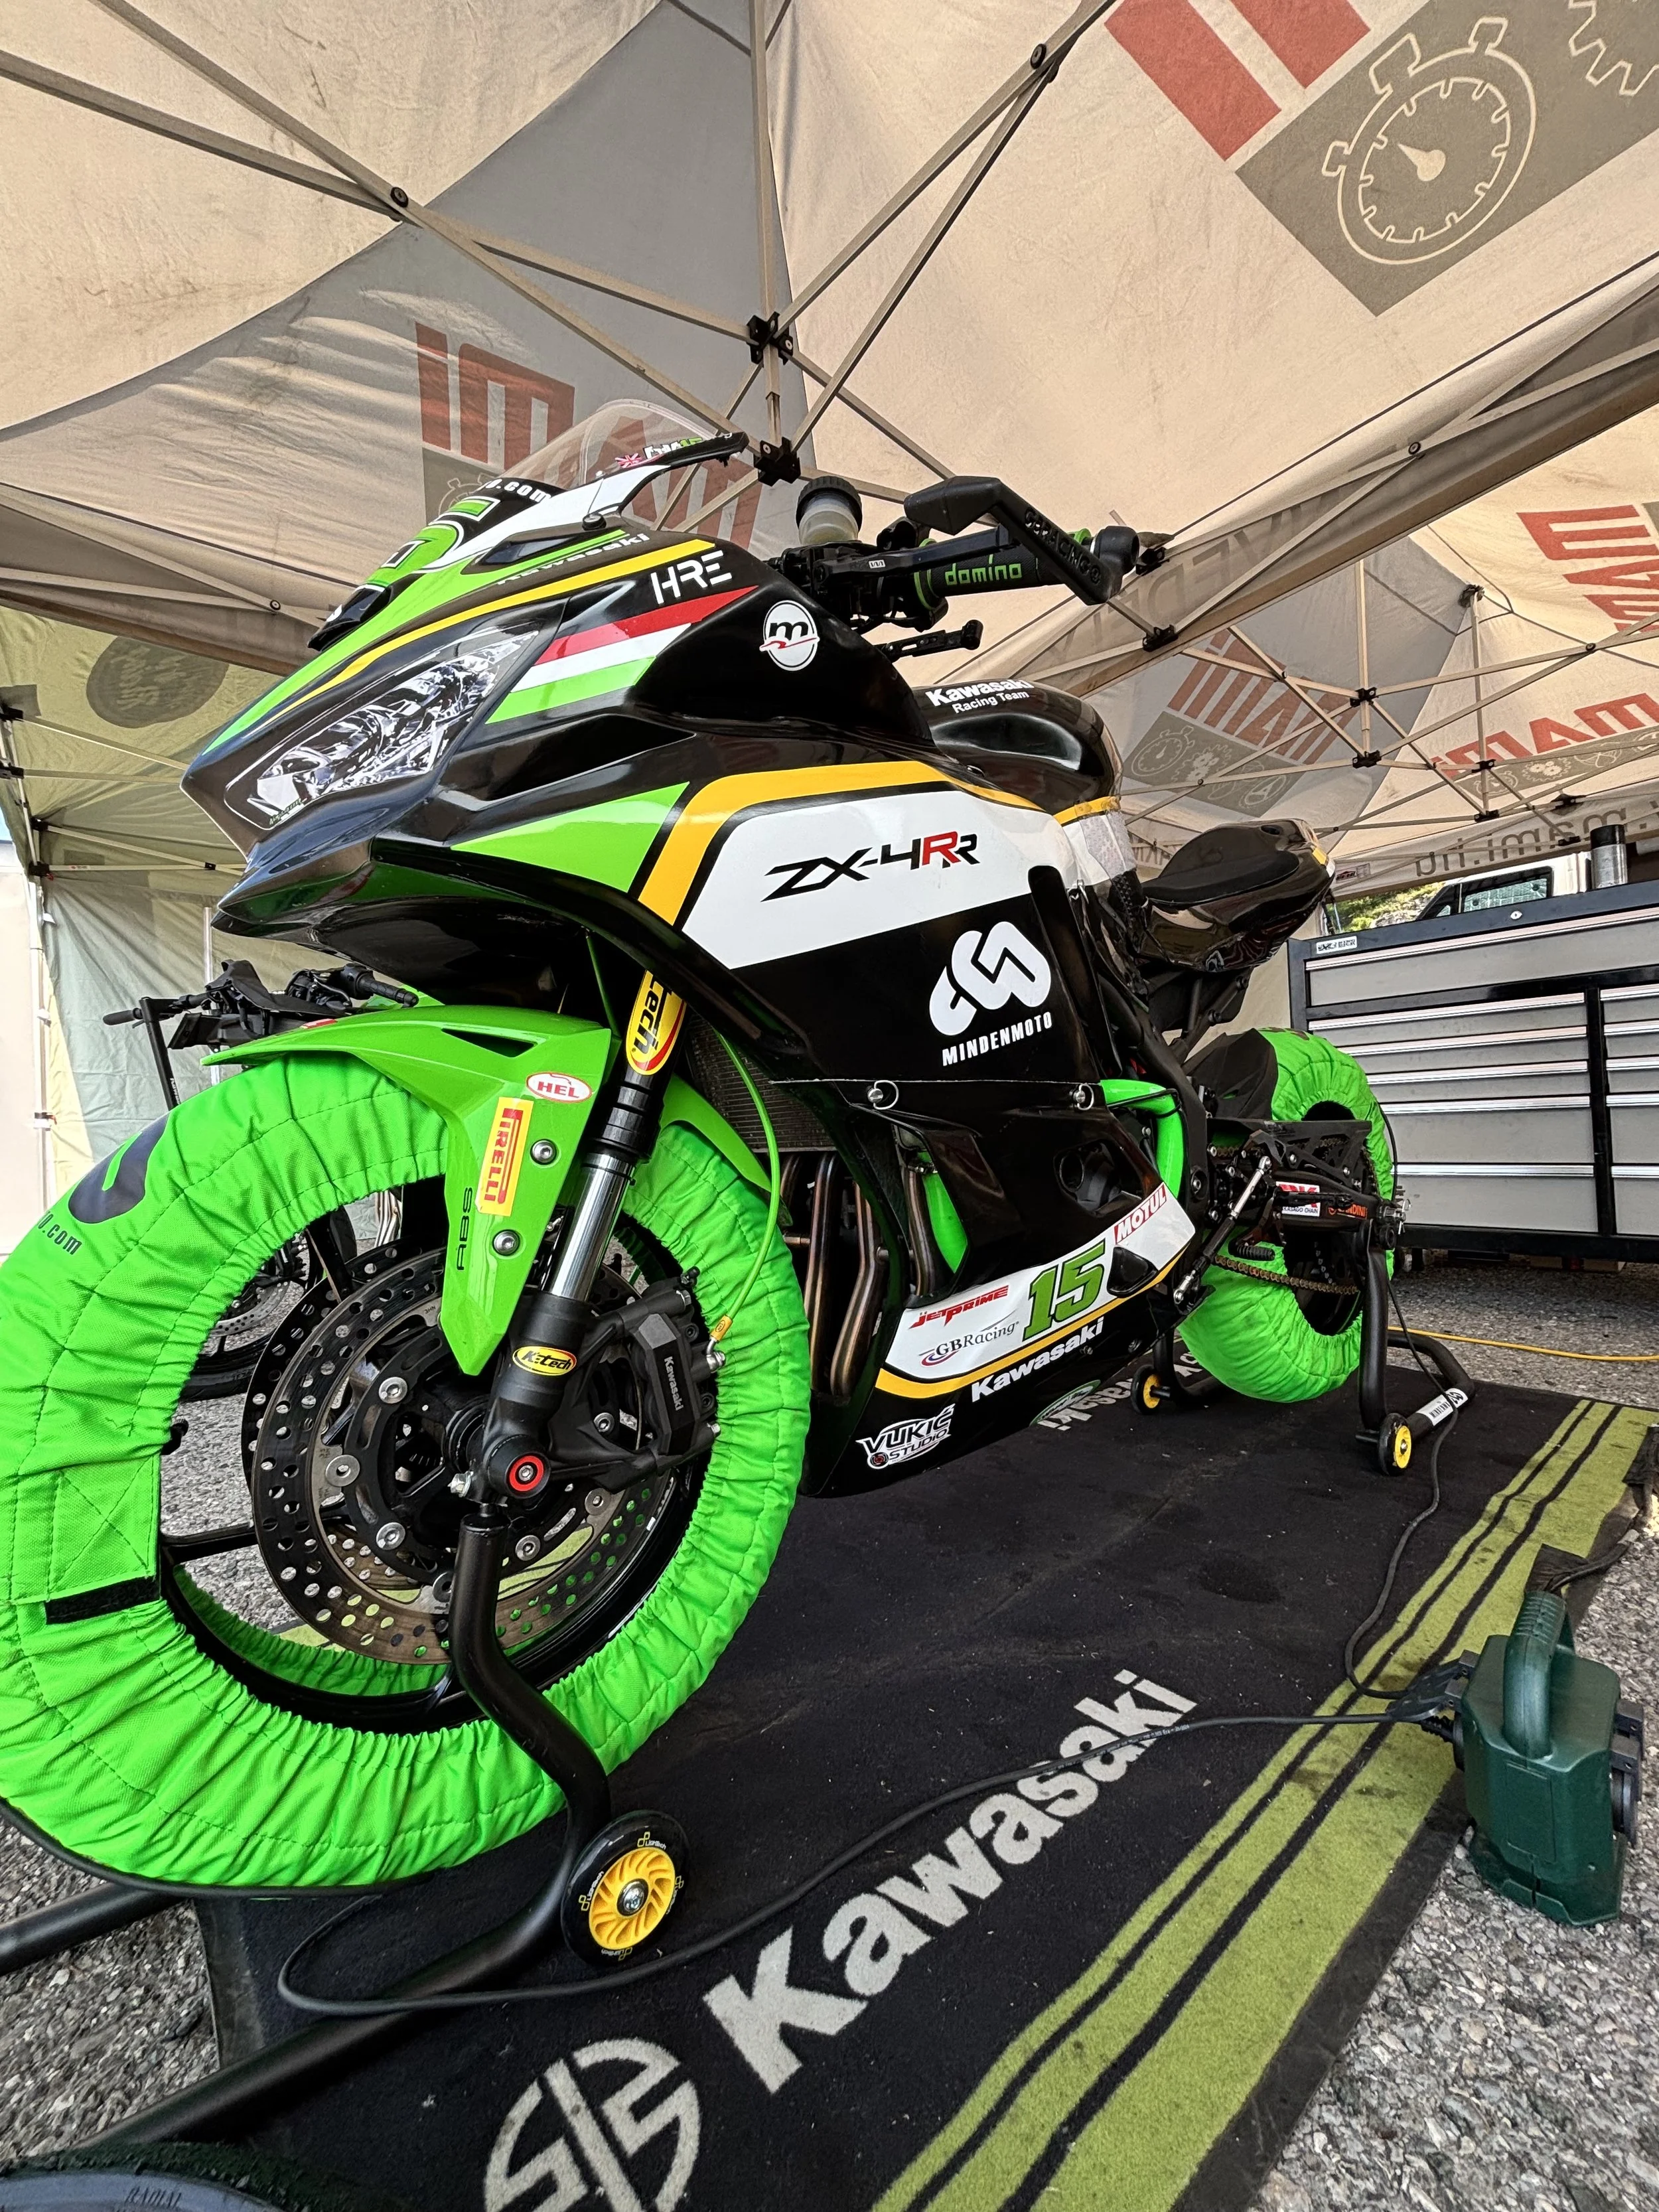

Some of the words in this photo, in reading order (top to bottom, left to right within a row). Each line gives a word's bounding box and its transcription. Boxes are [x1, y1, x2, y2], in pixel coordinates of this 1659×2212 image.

[650, 550, 732, 605] HRE
[945, 554, 1023, 586] domino
[925, 679, 1035, 707] Kawasaki
[952, 696, 998, 713] Racing
[996, 691, 1030, 701] Team
[760, 831, 980, 902] ZX-4RR
[942, 1012, 1052, 1066] MINDENMOTO
[537, 1081, 579, 1098] HEL
[484, 1108, 524, 1205] PIRELLI
[457, 1187, 472, 1270] ABS
[1116, 1185, 1167, 1243] MOTUL
[1022, 1240, 1106, 1342] 15
[664, 1356, 684, 1412] Kawasaki
[972, 1317, 1104, 1402] Kawasaki
[703, 1669, 1196, 2093] Kawasaki
